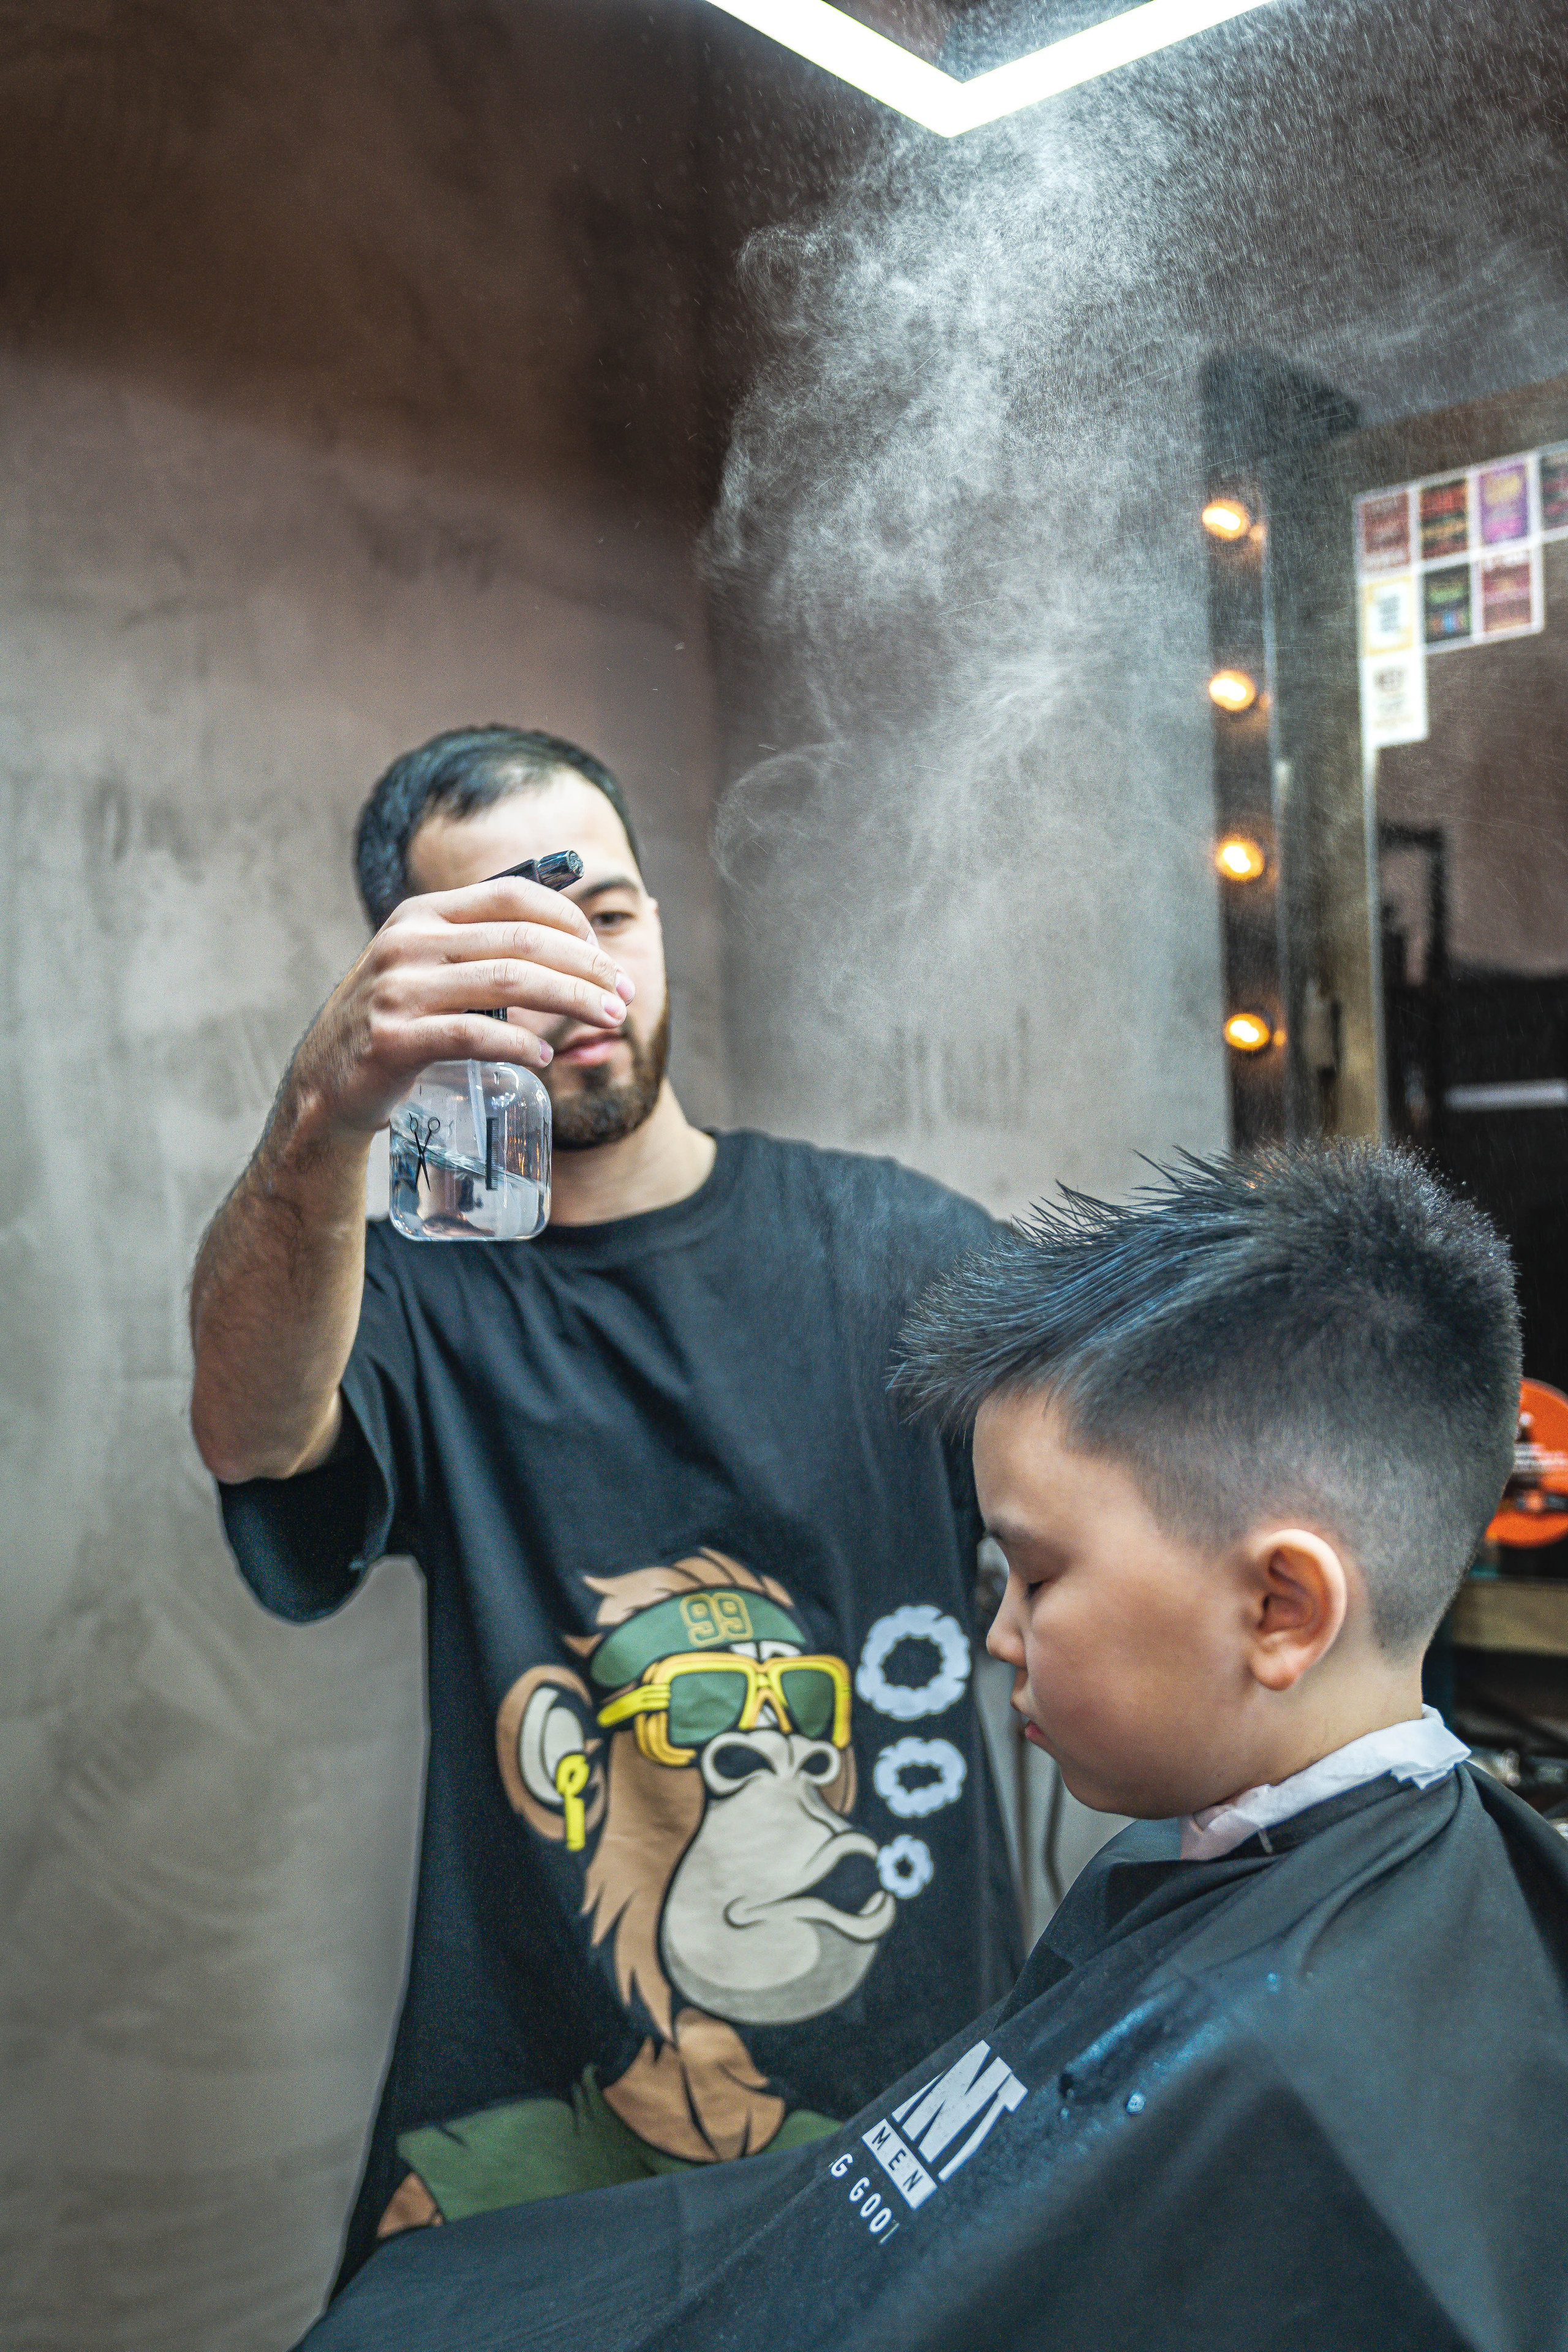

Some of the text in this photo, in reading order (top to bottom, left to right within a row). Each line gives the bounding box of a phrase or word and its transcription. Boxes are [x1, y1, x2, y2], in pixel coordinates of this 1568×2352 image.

[679, 1592, 754, 1648] 99
[828, 2152, 854, 2179] G
[871, 2125, 924, 2192] MEN
